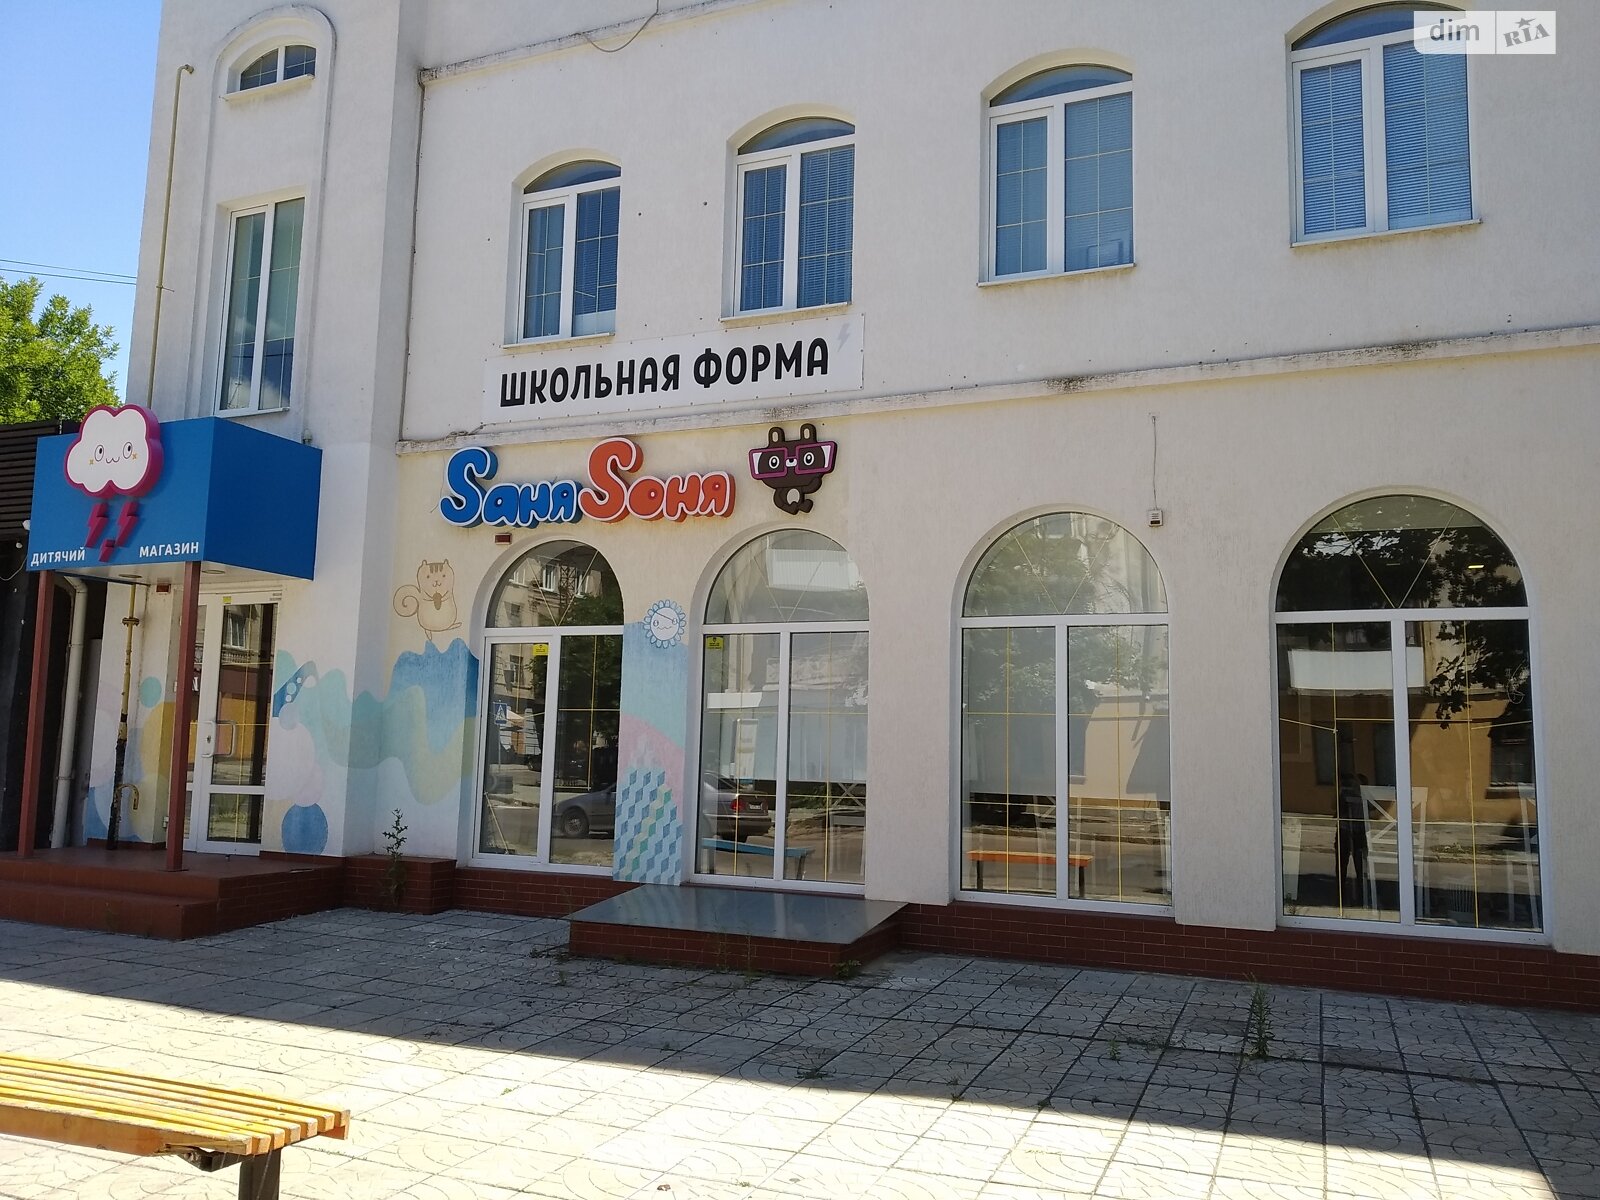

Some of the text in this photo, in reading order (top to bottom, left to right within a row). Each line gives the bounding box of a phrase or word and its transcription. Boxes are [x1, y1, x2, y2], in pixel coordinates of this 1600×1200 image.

[500, 337, 829, 408] ШКОЛЬНАЯ ФОРМА
[30, 541, 200, 567] ДИТЯЧИЙ МАГАЗИН
